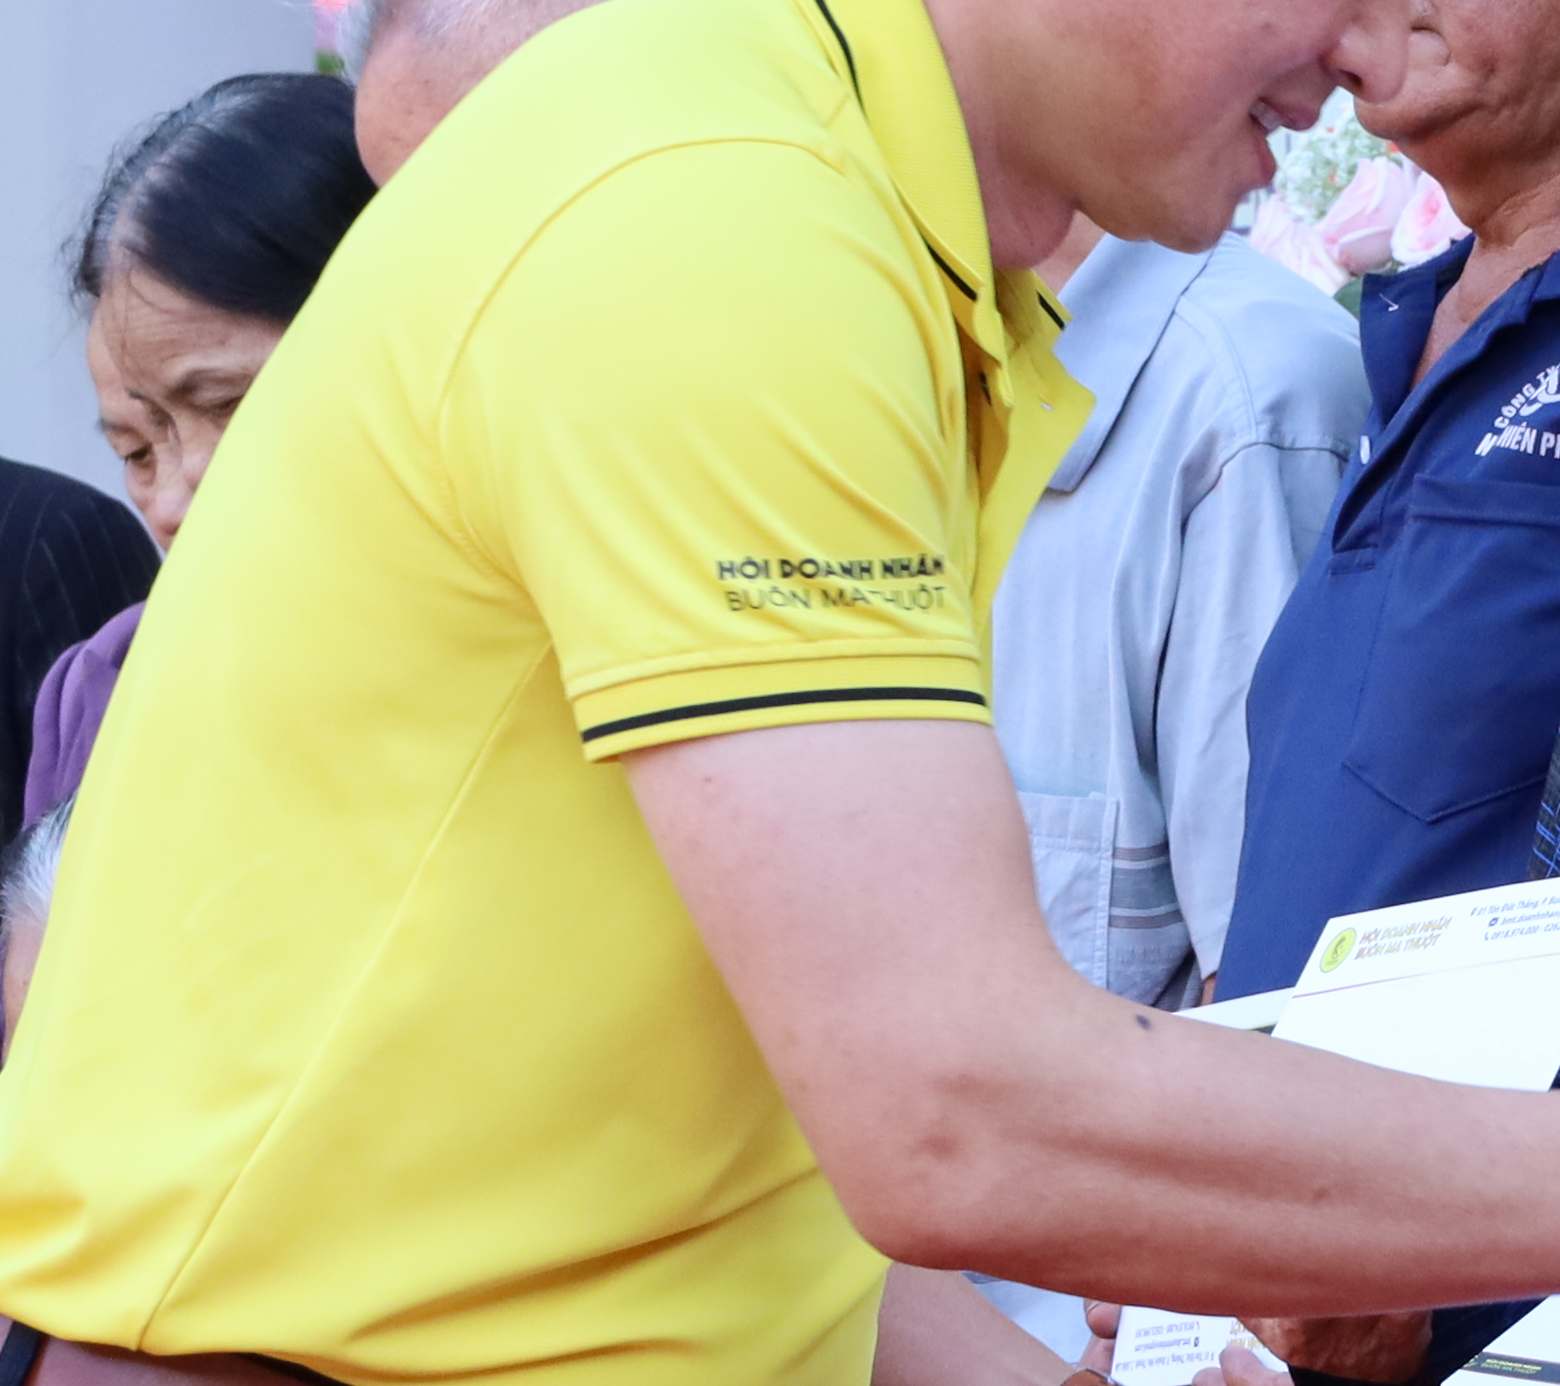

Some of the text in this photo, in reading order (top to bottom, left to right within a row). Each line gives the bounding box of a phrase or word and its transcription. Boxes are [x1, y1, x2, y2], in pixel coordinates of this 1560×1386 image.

[718, 553, 945, 582] HỘI DOANH NHÂN
[725, 586, 812, 612] BUÔN
[820, 587, 870, 608] MA
